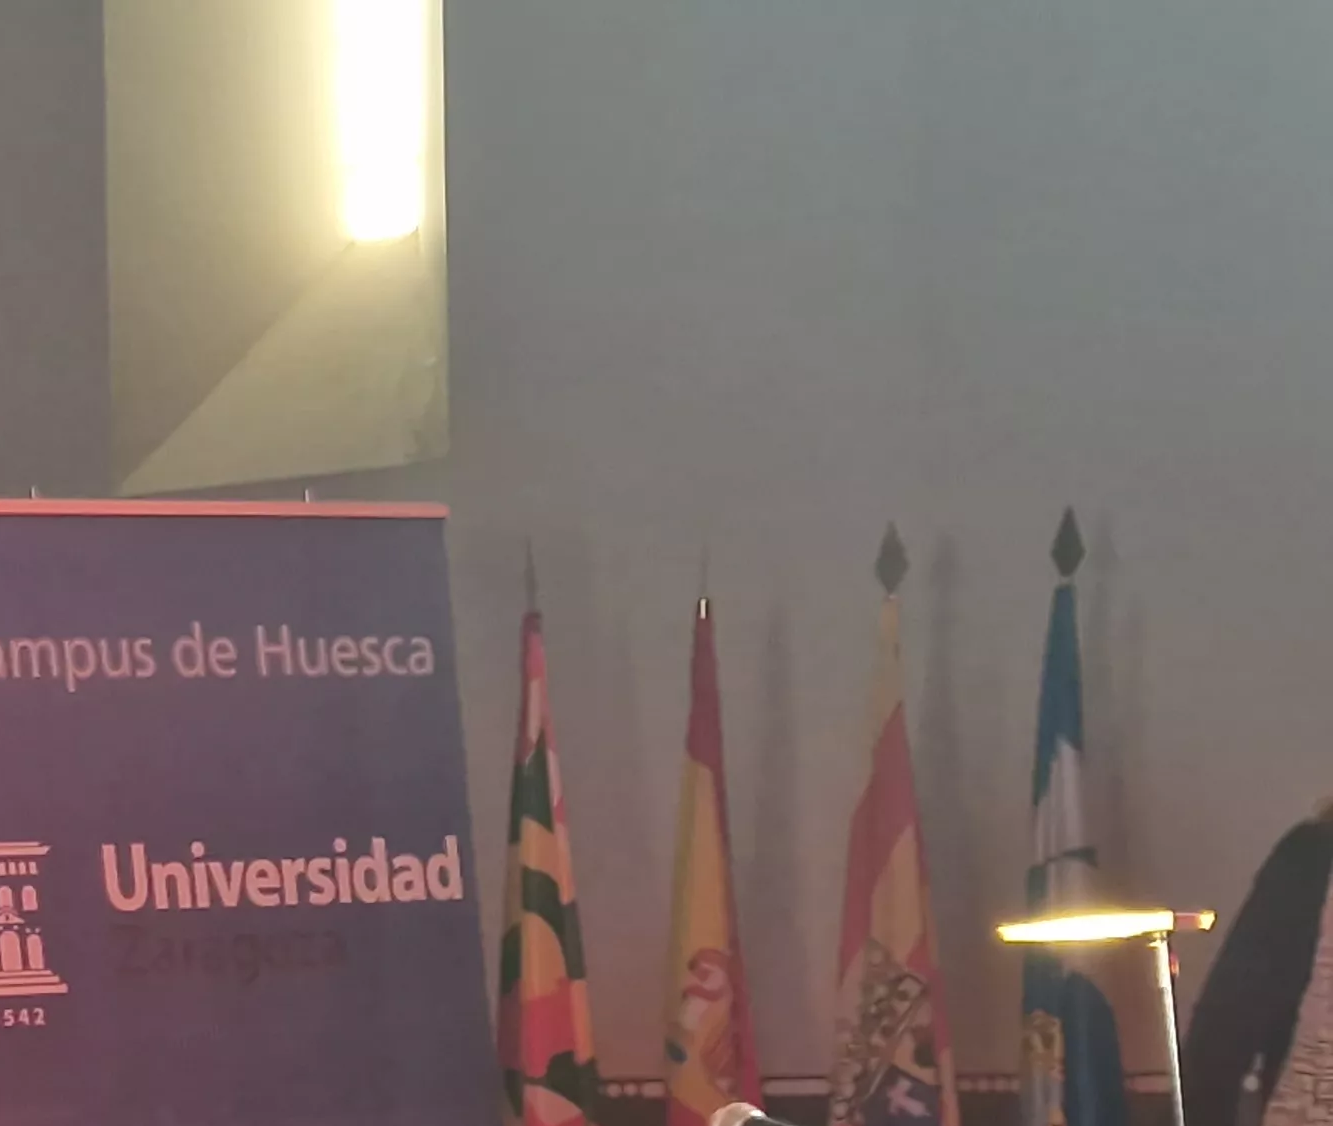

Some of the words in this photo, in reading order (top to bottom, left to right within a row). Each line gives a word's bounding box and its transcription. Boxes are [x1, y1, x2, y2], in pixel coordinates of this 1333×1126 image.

[173, 622, 238, 678] de
[255, 624, 435, 676] Huesca
[101, 836, 465, 911] Universidad
